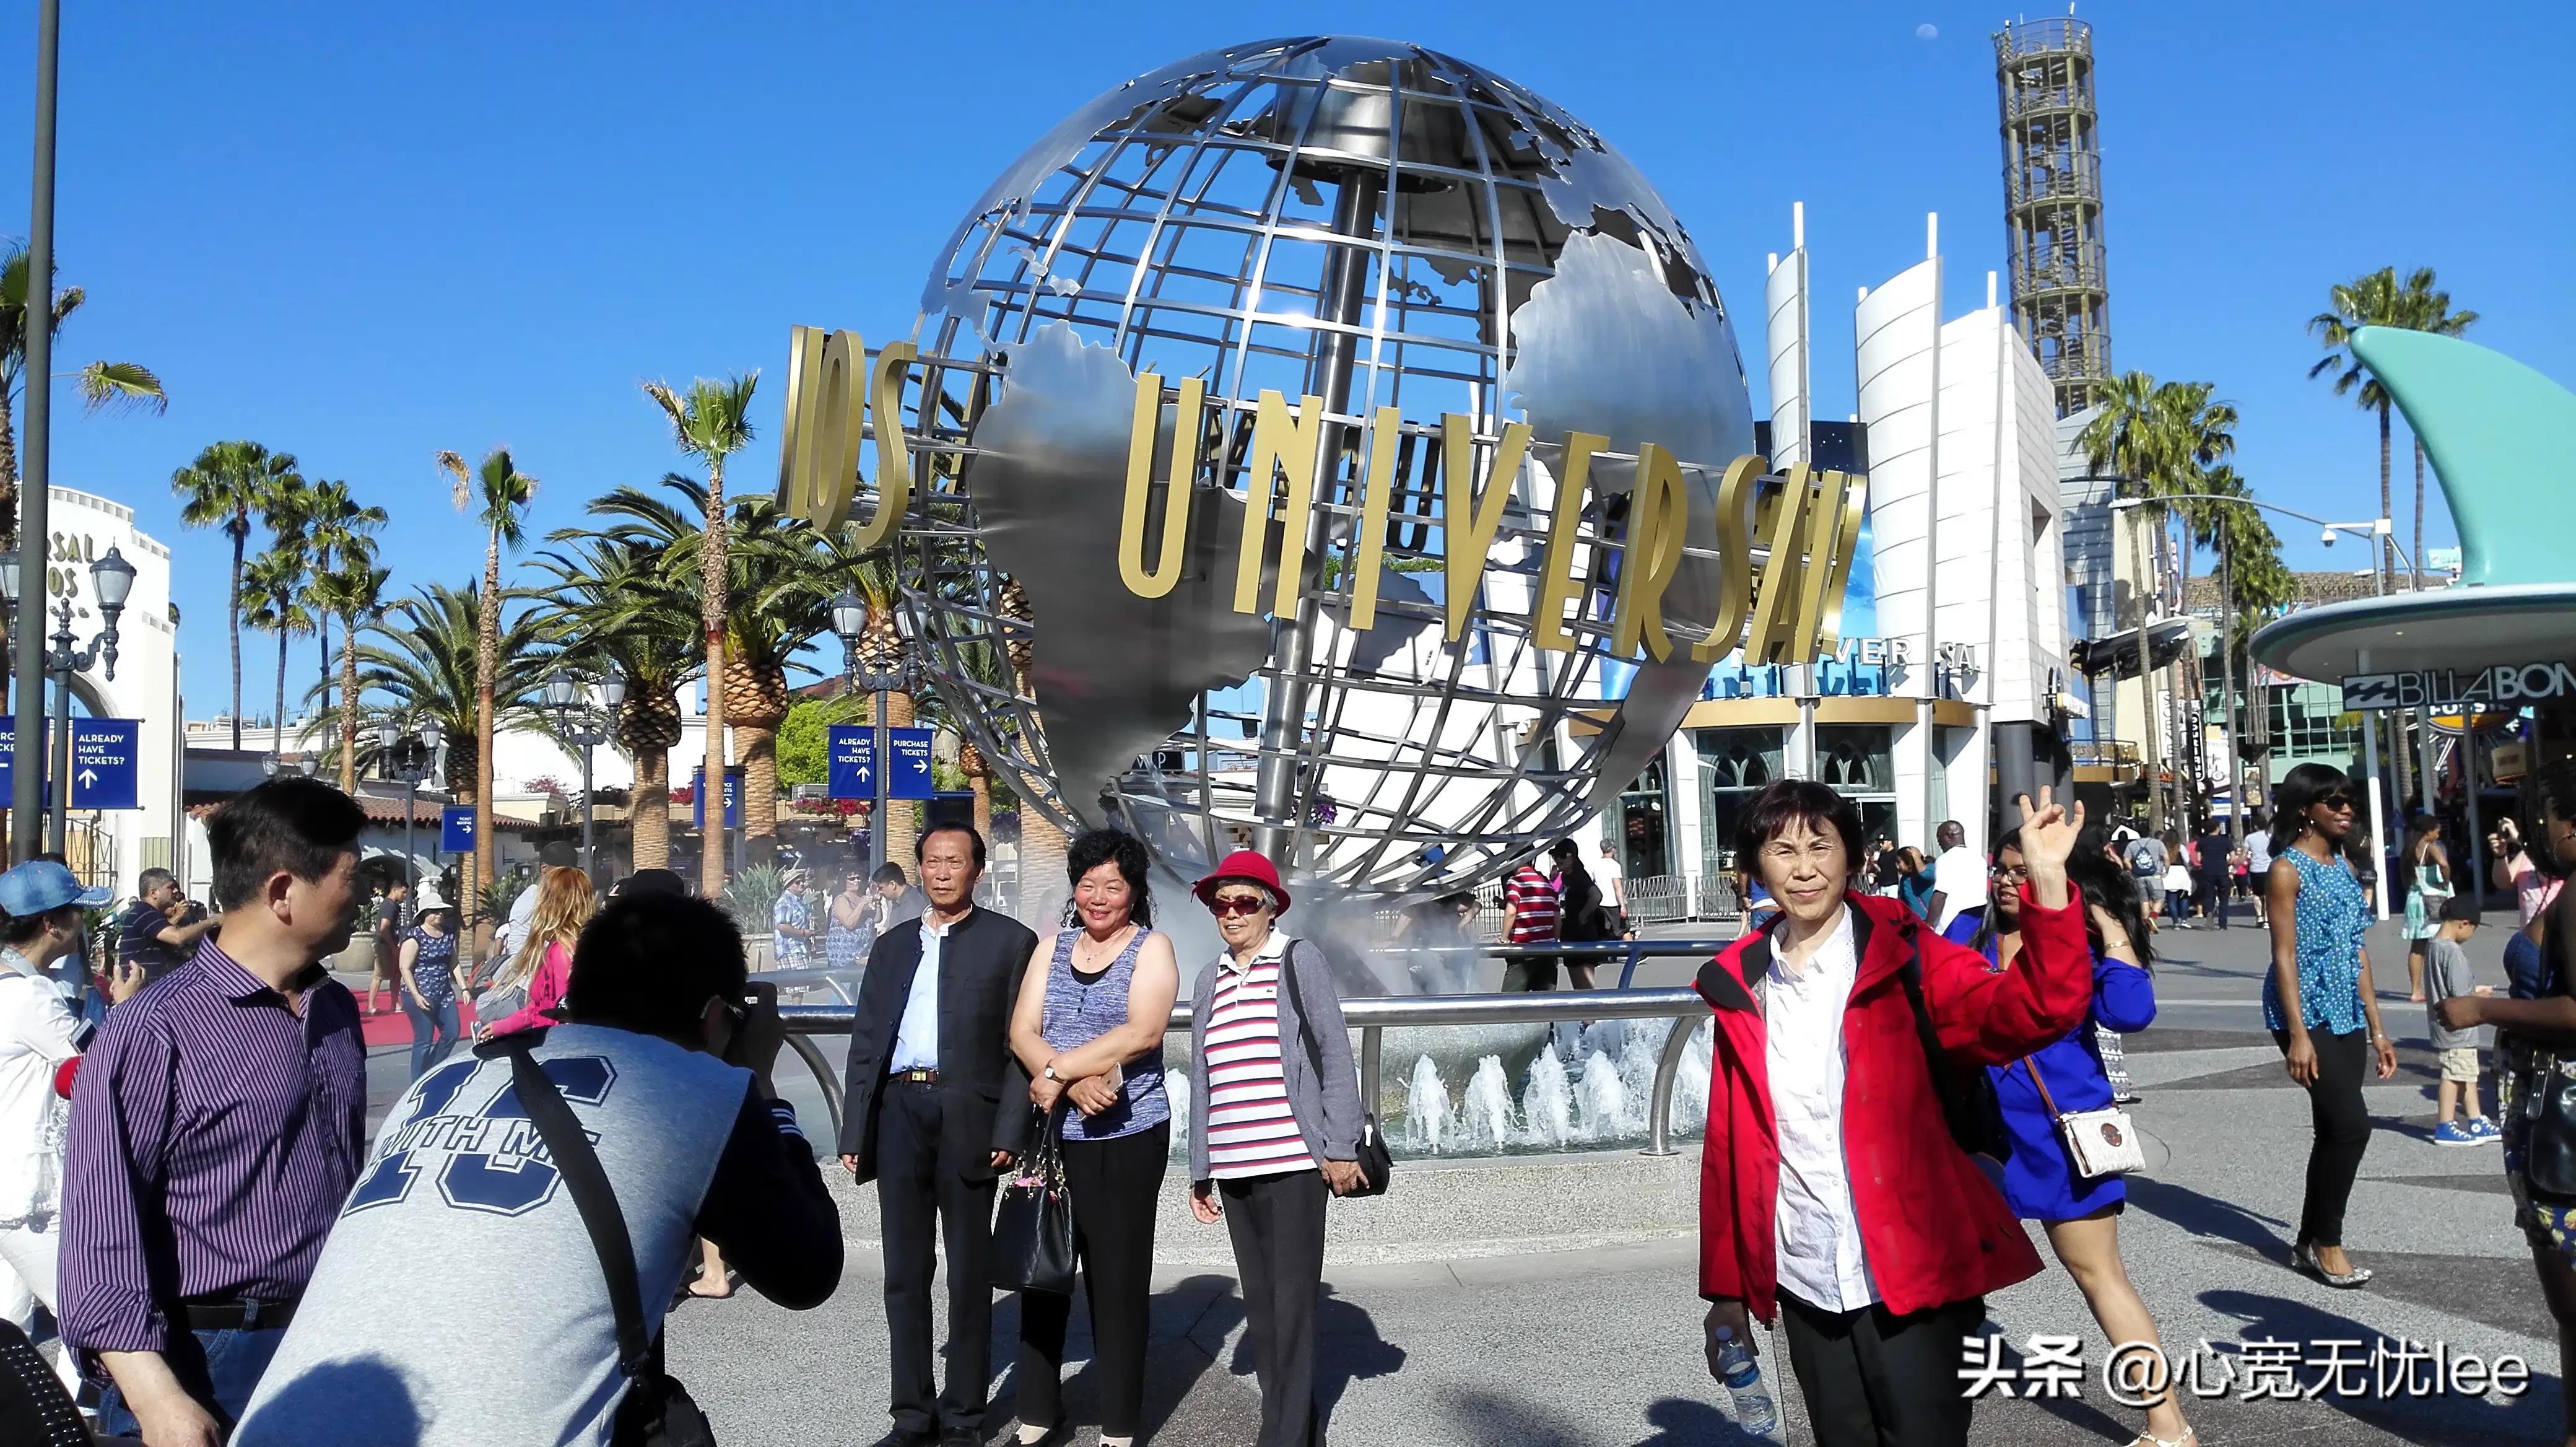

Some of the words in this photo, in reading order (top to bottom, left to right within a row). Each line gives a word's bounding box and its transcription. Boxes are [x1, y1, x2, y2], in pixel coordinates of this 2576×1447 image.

[78, 735, 124, 743] ALREADY
[78, 745, 105, 754] HAVE
[78, 756, 124, 765] TICKETS?
[838, 755, 871, 763] TICKETS?
[370, 1114, 491, 1167] WITH
